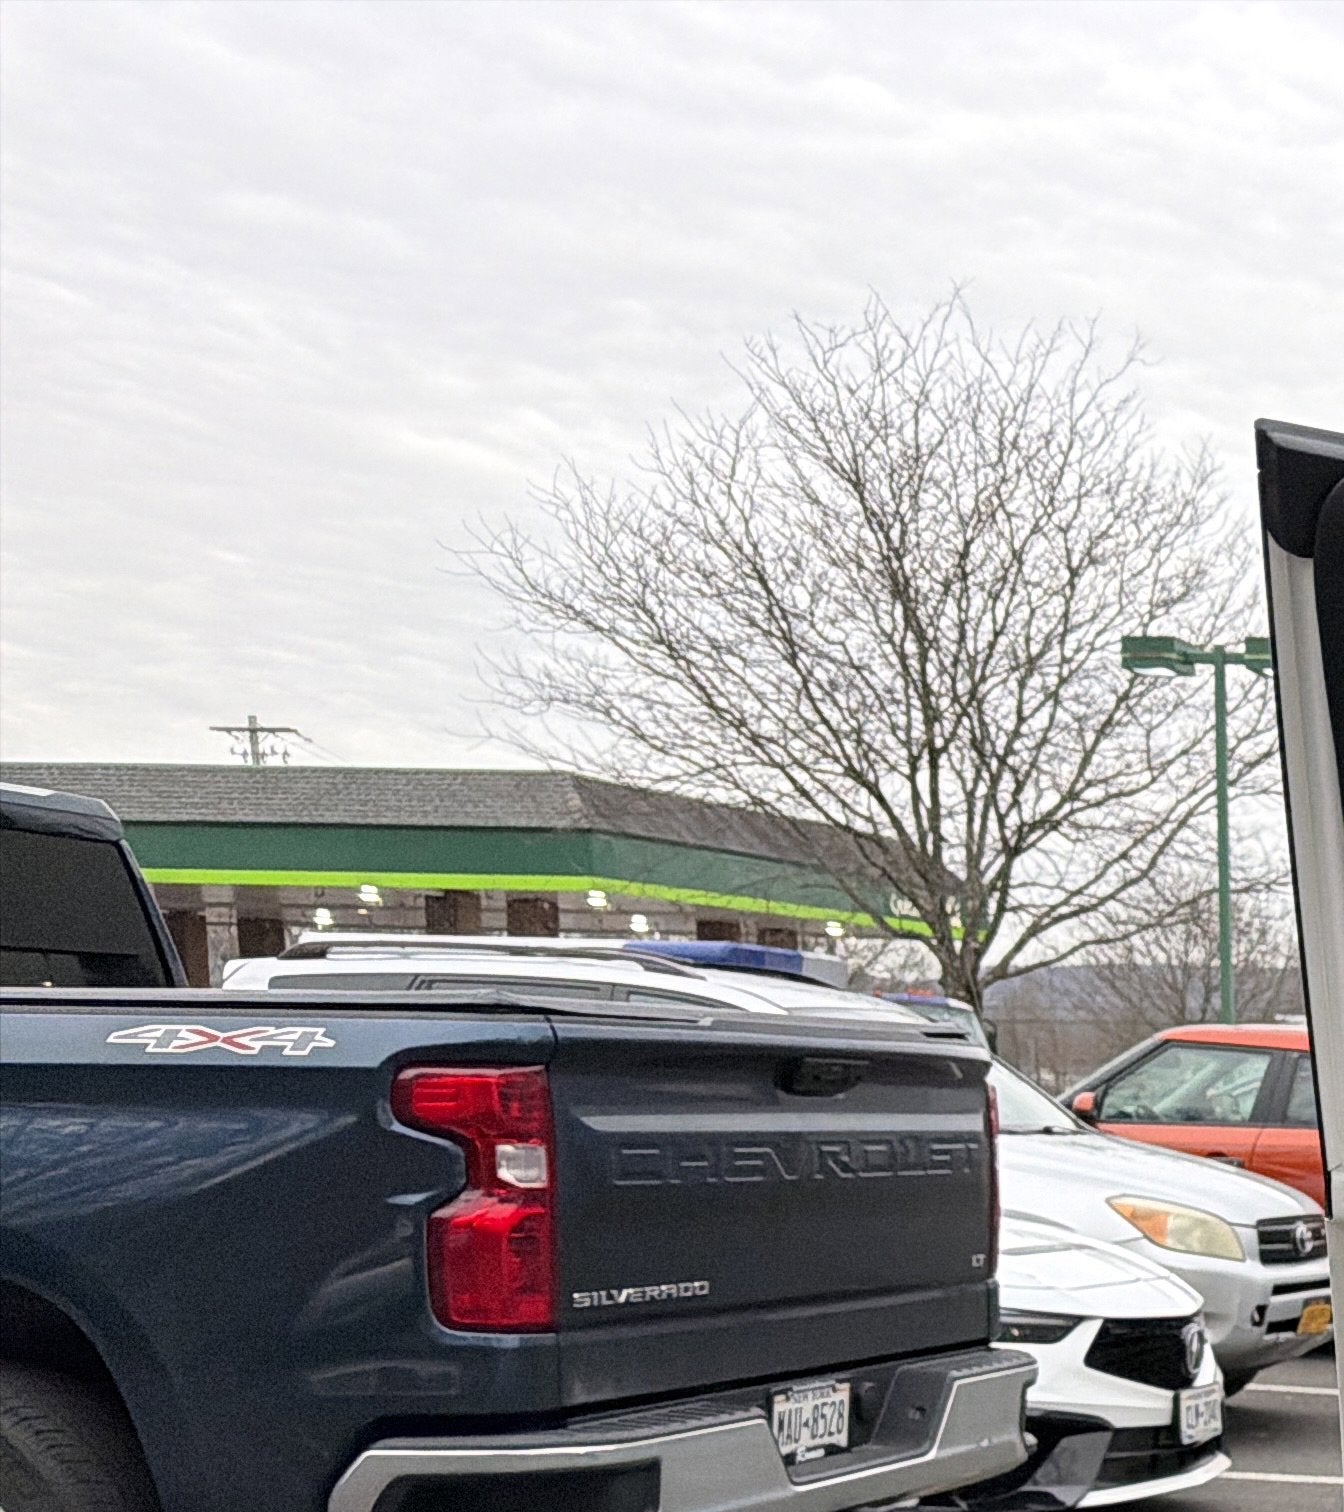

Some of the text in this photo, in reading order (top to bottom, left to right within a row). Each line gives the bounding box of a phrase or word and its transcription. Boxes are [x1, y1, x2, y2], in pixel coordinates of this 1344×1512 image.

[613, 1141, 979, 1186] CHEVROLET
[971, 1254, 986, 1267] LT
[572, 1281, 710, 1308] SILVERADO
